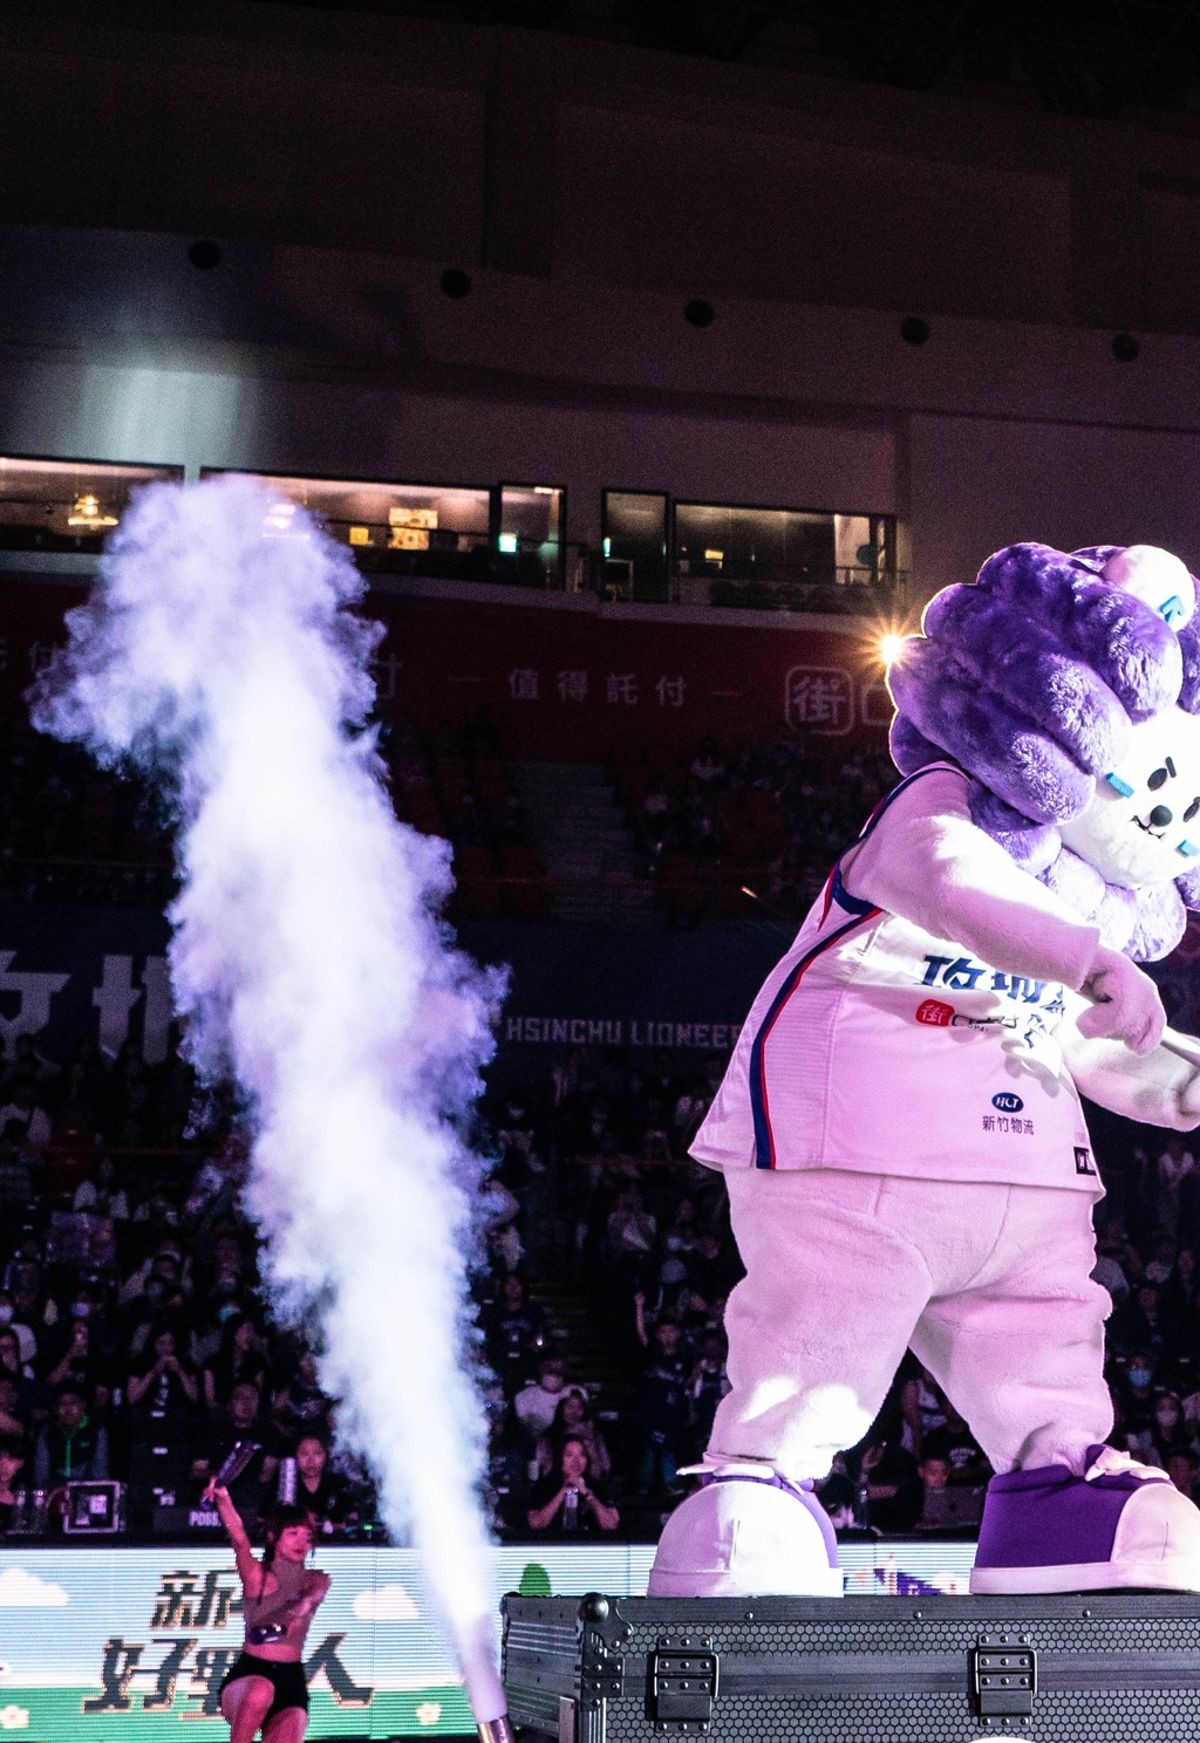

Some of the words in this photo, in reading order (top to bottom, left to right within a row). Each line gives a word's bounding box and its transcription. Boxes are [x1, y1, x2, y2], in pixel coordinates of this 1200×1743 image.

[505, 1016, 622, 1044] HSINCHU
[982, 1115, 1035, 1135] 新竹物流
